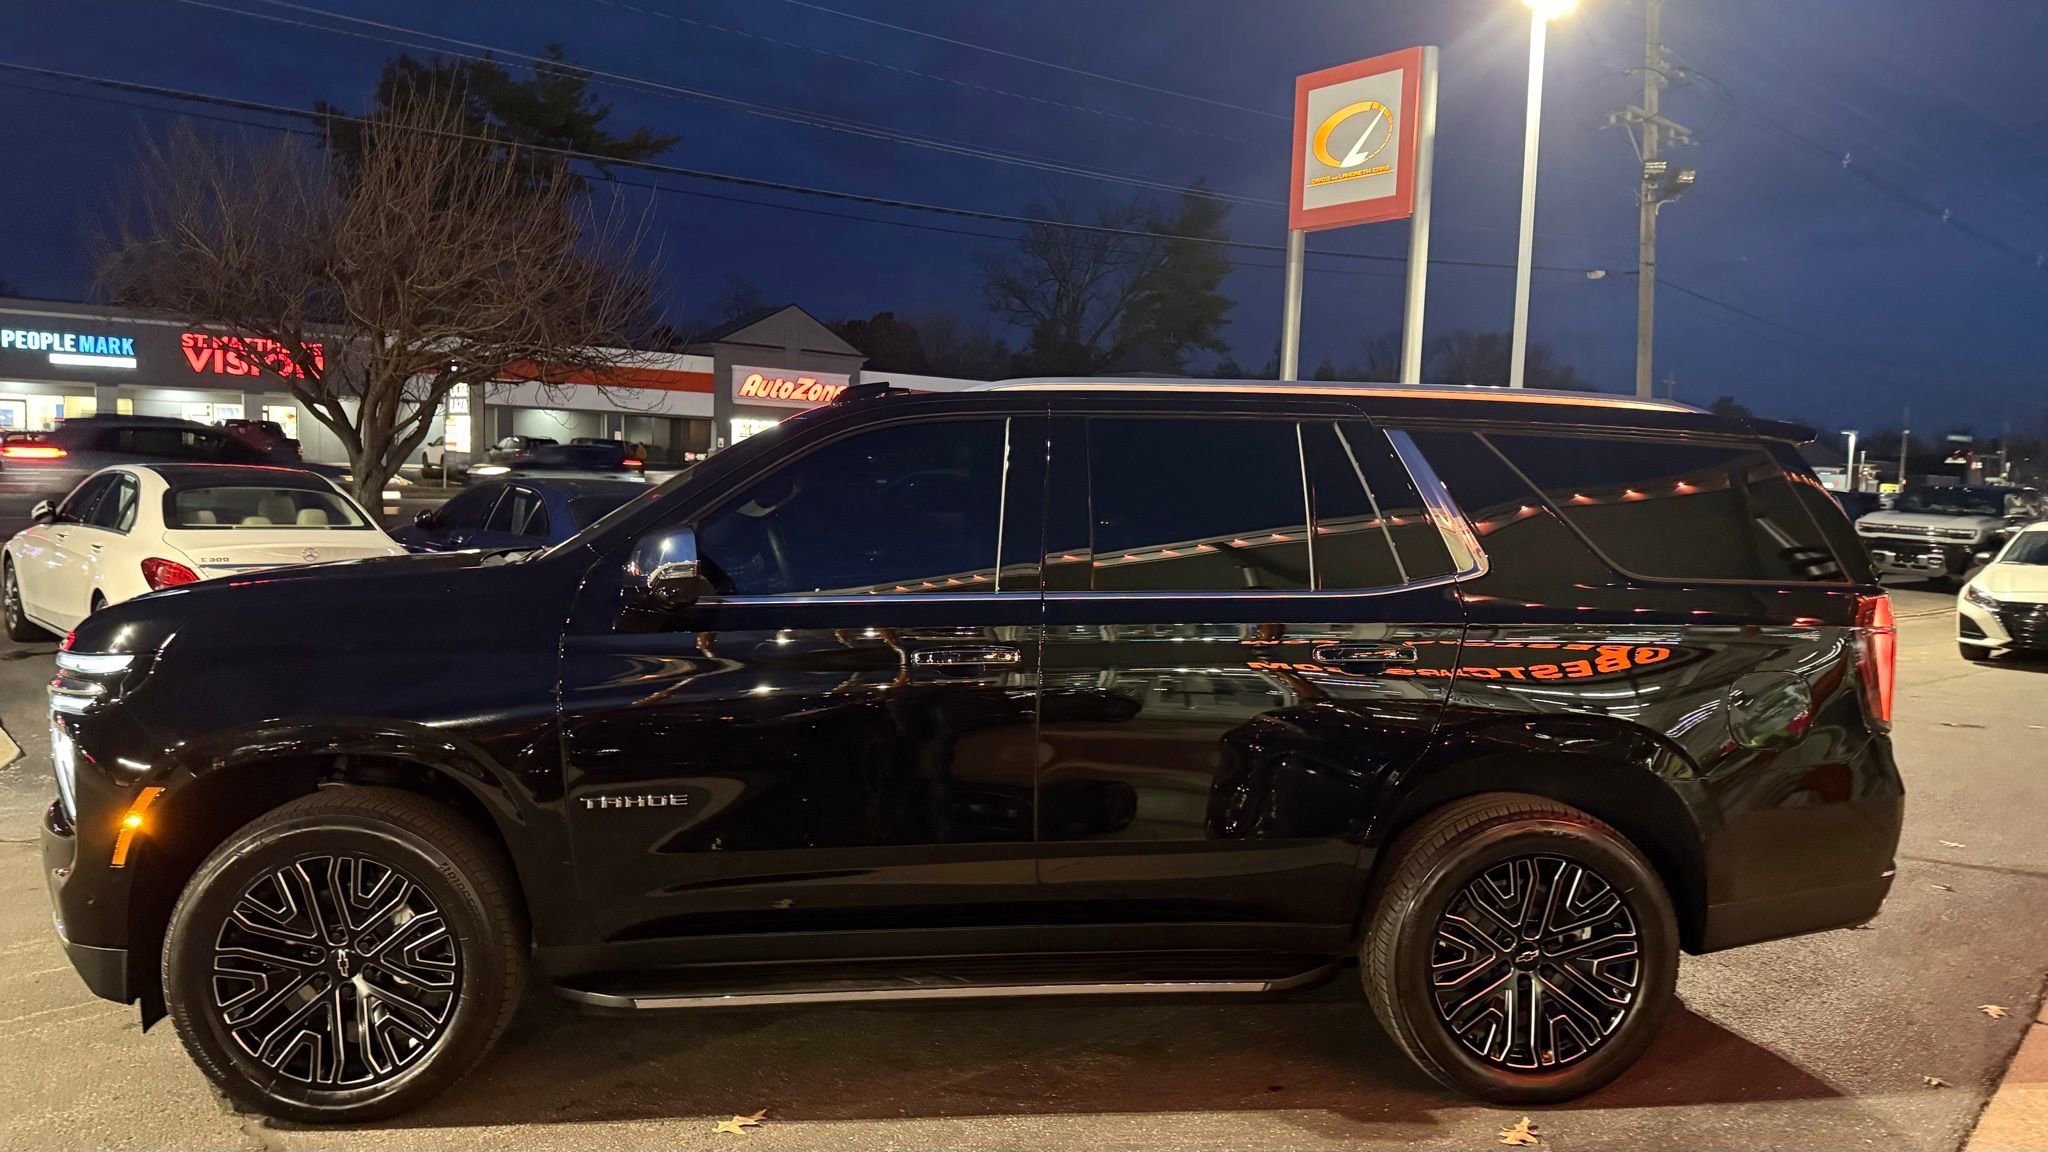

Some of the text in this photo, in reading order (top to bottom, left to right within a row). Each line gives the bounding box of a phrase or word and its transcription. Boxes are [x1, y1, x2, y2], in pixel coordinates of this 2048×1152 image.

[181, 332, 323, 356] ST. MATTHS
[580, 793, 689, 810] TAHOE
